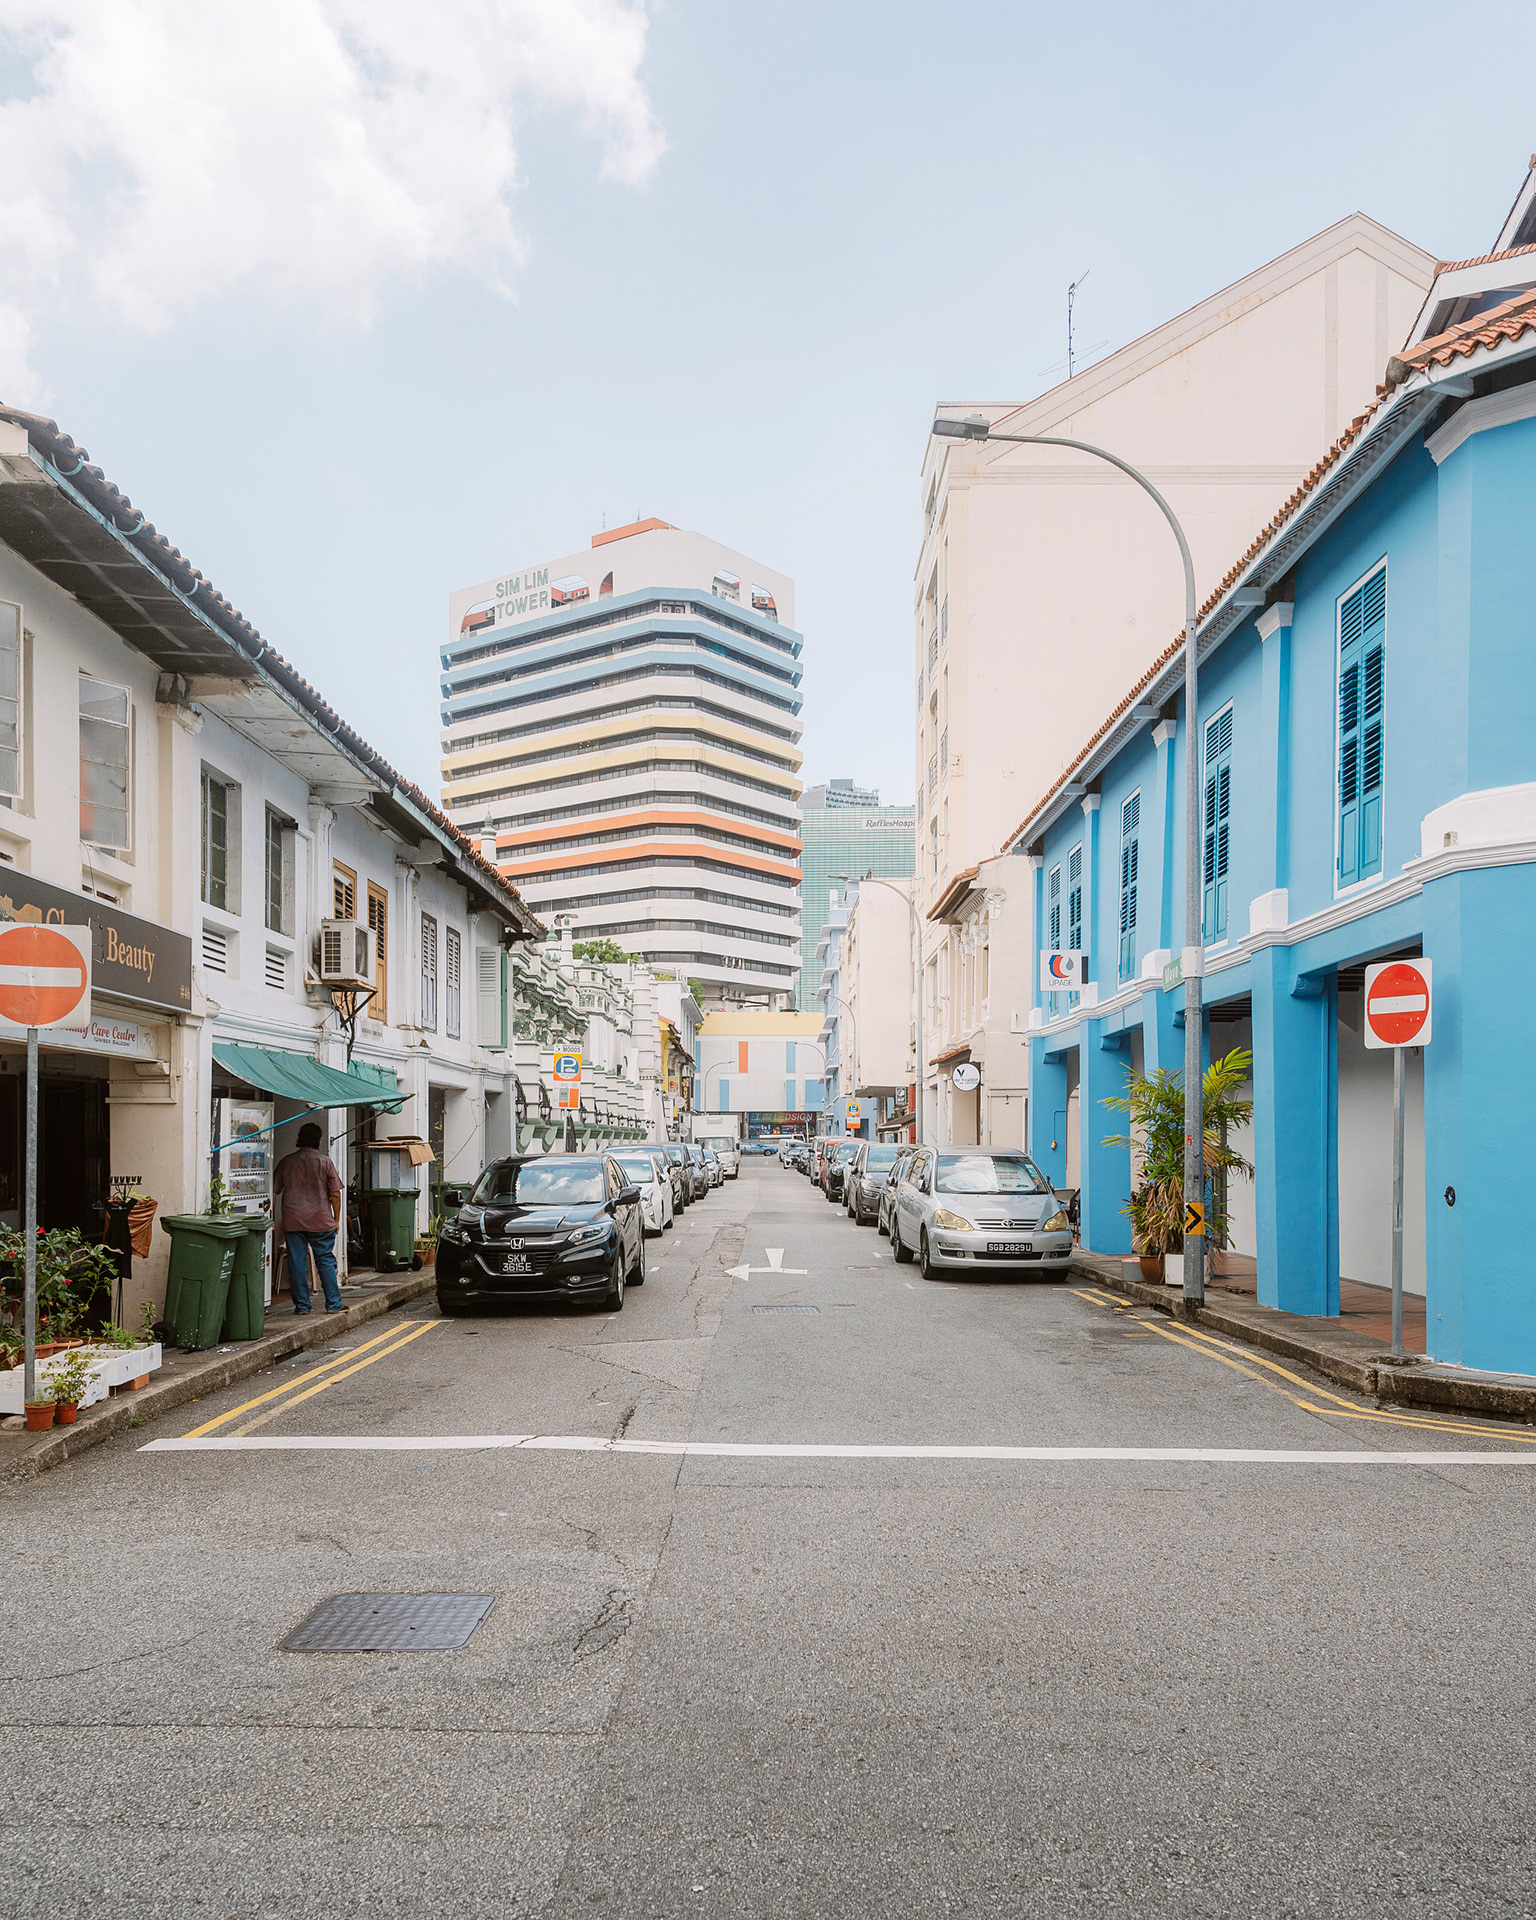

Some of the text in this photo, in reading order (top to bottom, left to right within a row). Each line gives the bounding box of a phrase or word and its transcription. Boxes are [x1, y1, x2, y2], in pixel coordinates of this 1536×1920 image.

[496, 568, 548, 599] SIM LIM
[496, 591, 548, 619] TOWER
[106, 927, 155, 983] Beauty
[1165, 966, 1179, 985] Mayo
[91, 1022, 110, 1038] Care
[112, 1025, 136, 1042] Centre
[773, 1112, 813, 1121] LEDSIGN
[1187, 1135, 1193, 1147] 5
[988, 1243, 1032, 1252] SGB2829U
[507, 1254, 527, 1263] SKW
[502, 1262, 532, 1272] 3615E
